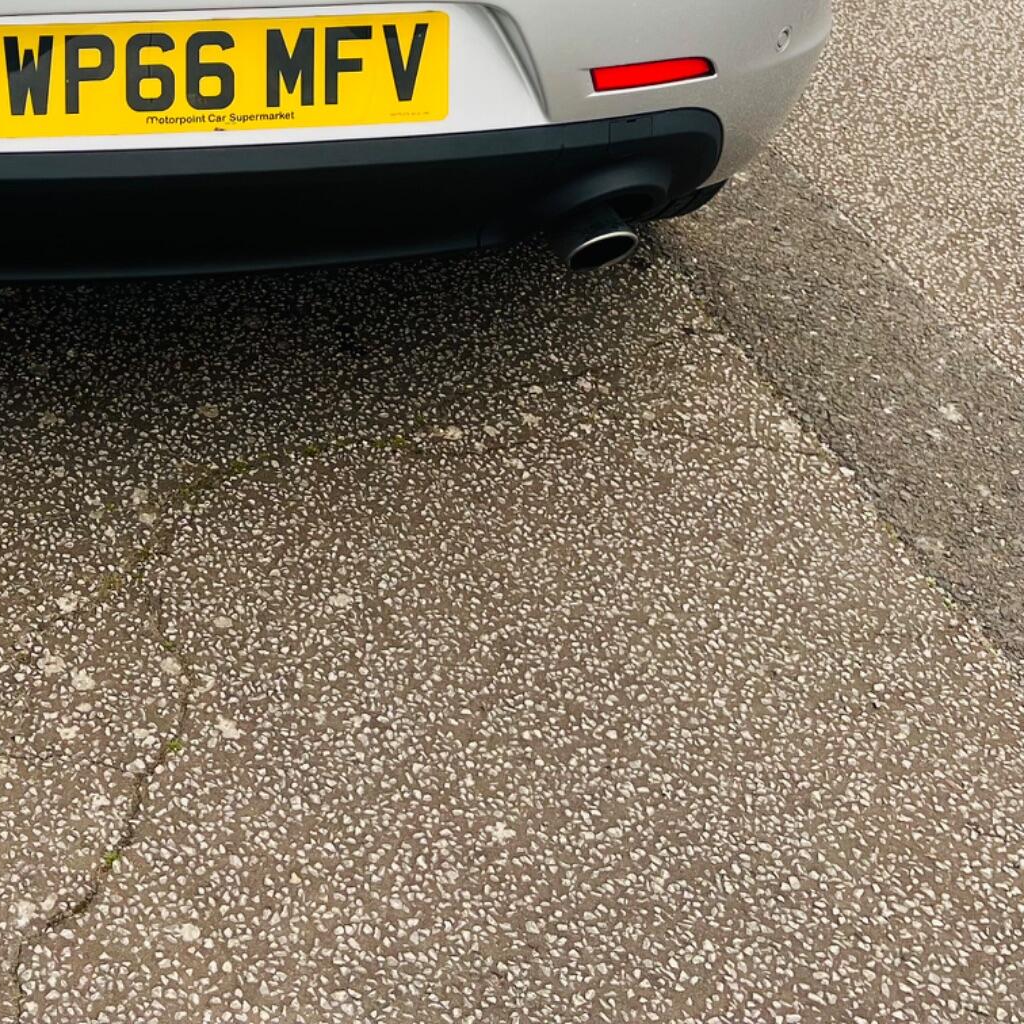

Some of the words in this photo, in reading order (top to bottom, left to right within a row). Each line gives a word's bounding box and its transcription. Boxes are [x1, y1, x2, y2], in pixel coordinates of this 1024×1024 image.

[3, 31, 235, 116] WP66
[266, 23, 429, 108] MFV
[145, 114, 206, 125] Motorpoint
[208, 113, 226, 123] Car
[229, 111, 295, 123] Supermarket
